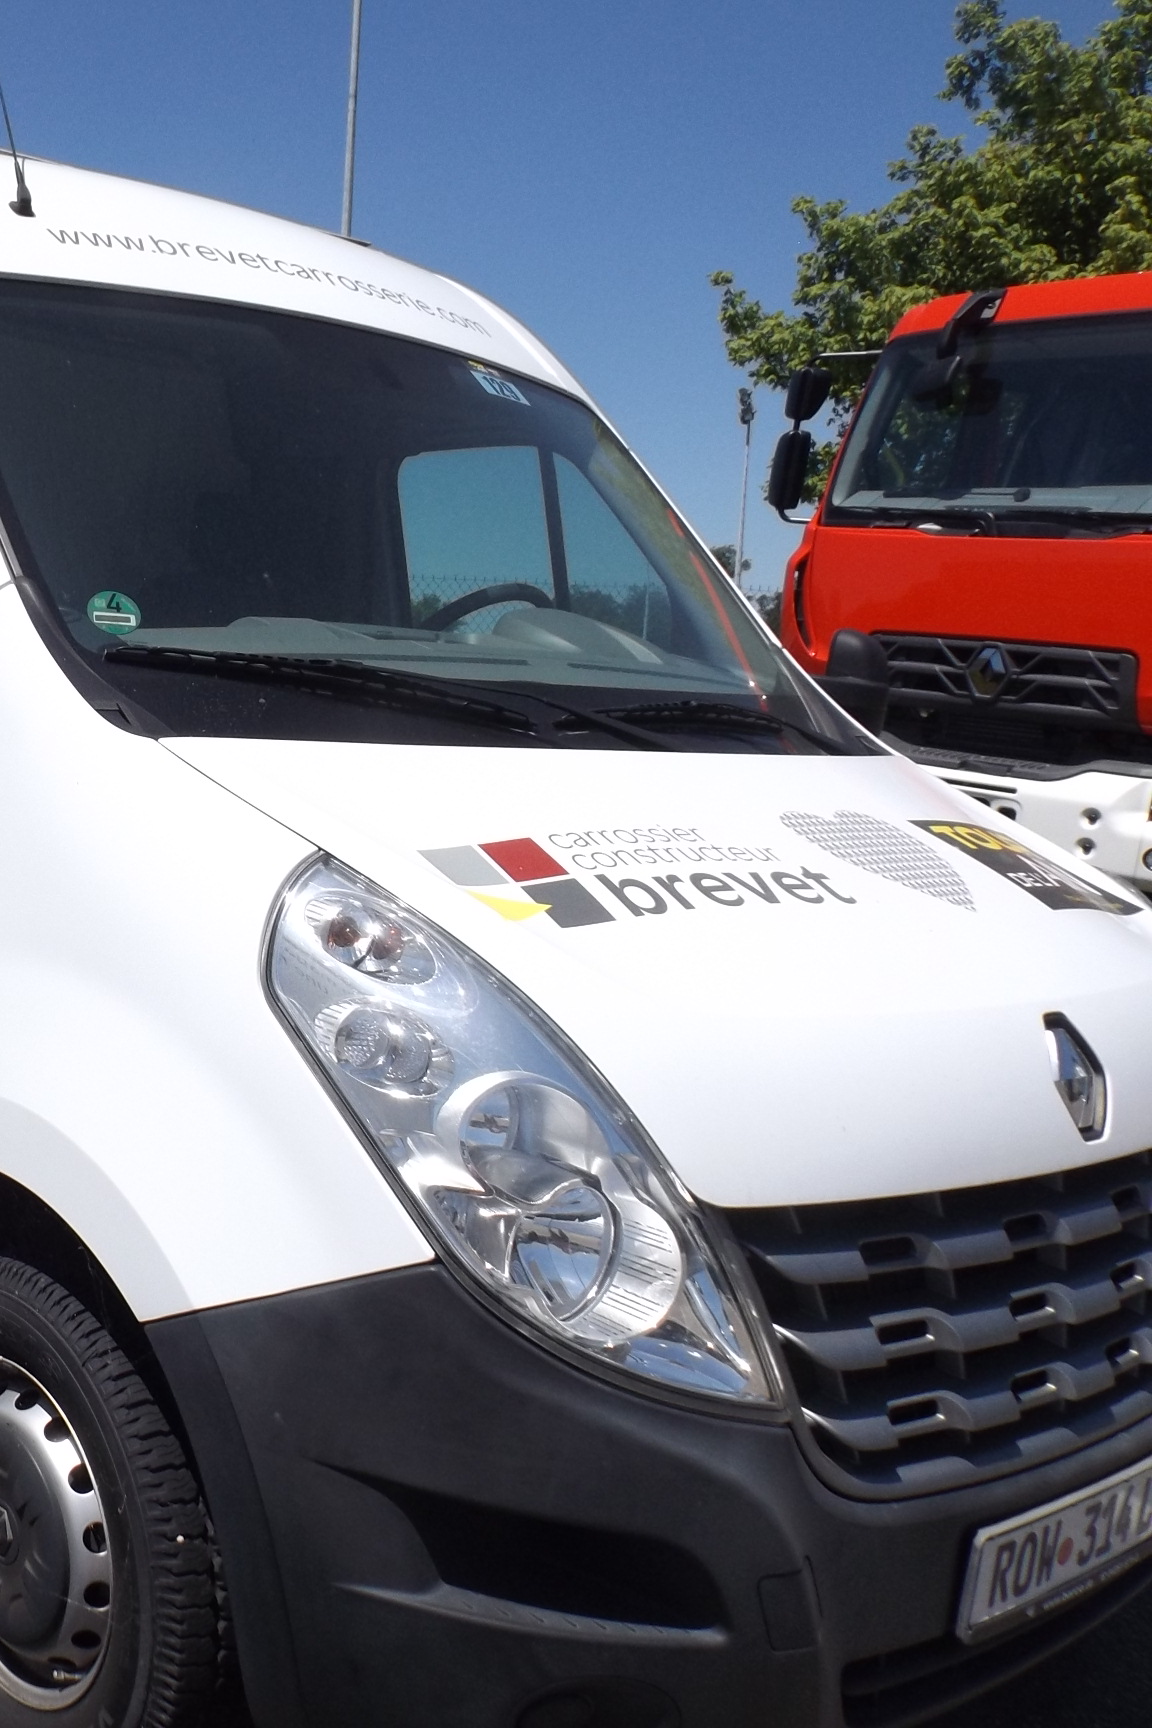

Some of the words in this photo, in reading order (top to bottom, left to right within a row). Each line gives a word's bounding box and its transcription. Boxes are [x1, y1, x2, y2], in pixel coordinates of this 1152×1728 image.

[46, 228, 492, 338] www.brevetcarrosserie.com
[481, 376, 521, 401] 129
[106, 593, 122, 613] 4
[548, 824, 706, 850] carrossier
[571, 844, 783, 871] constructeur
[594, 866, 858, 917] brevet
[987, 1518, 1064, 1609] ROW
